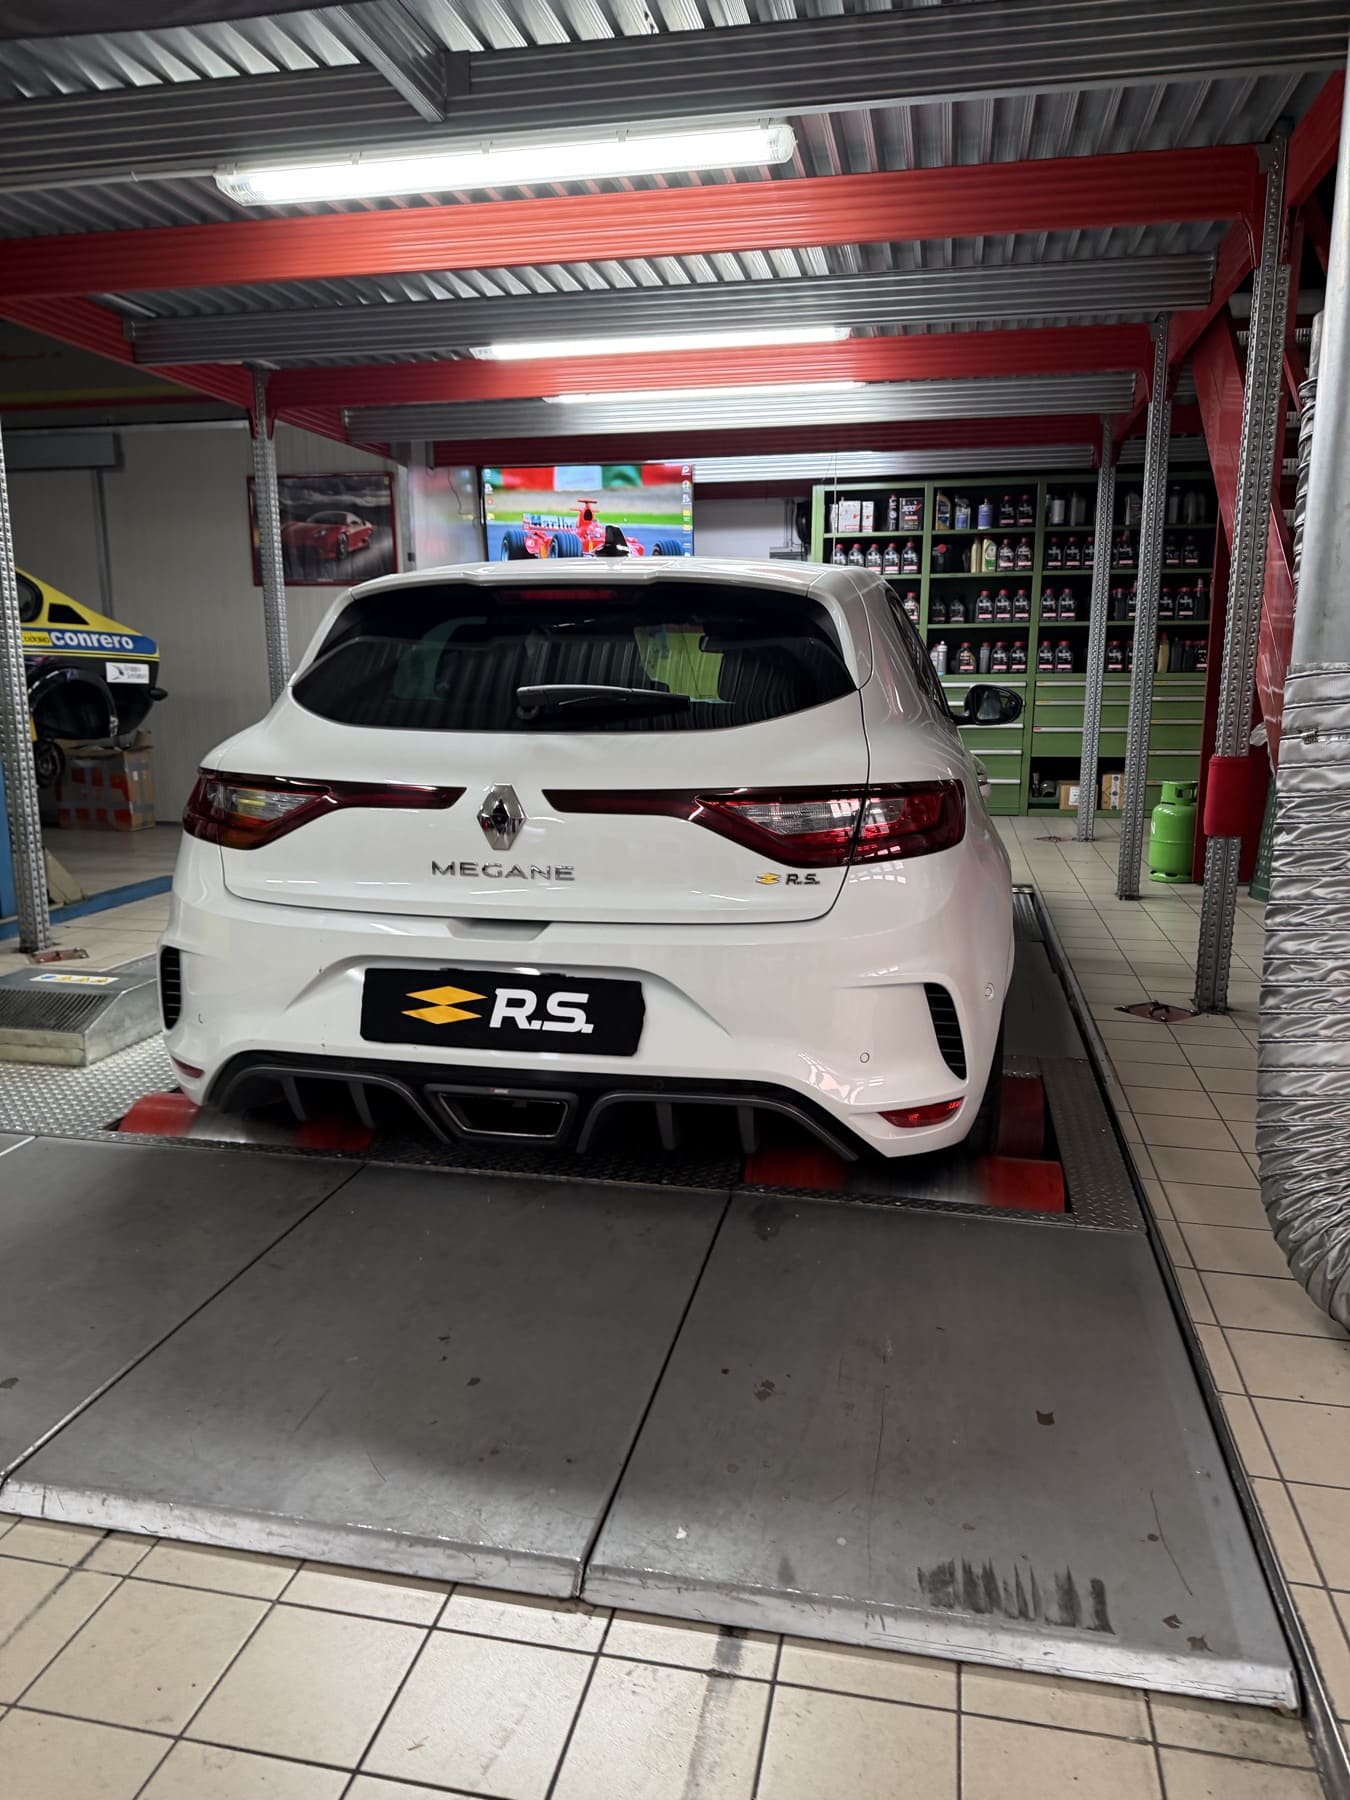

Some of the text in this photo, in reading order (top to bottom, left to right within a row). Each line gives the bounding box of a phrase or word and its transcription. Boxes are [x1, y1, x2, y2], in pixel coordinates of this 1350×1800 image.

[51, 631, 134, 649] conrero
[431, 860, 576, 881] MEGANE
[785, 873, 820, 885] R.S.
[489, 988, 594, 1033] R.S.
